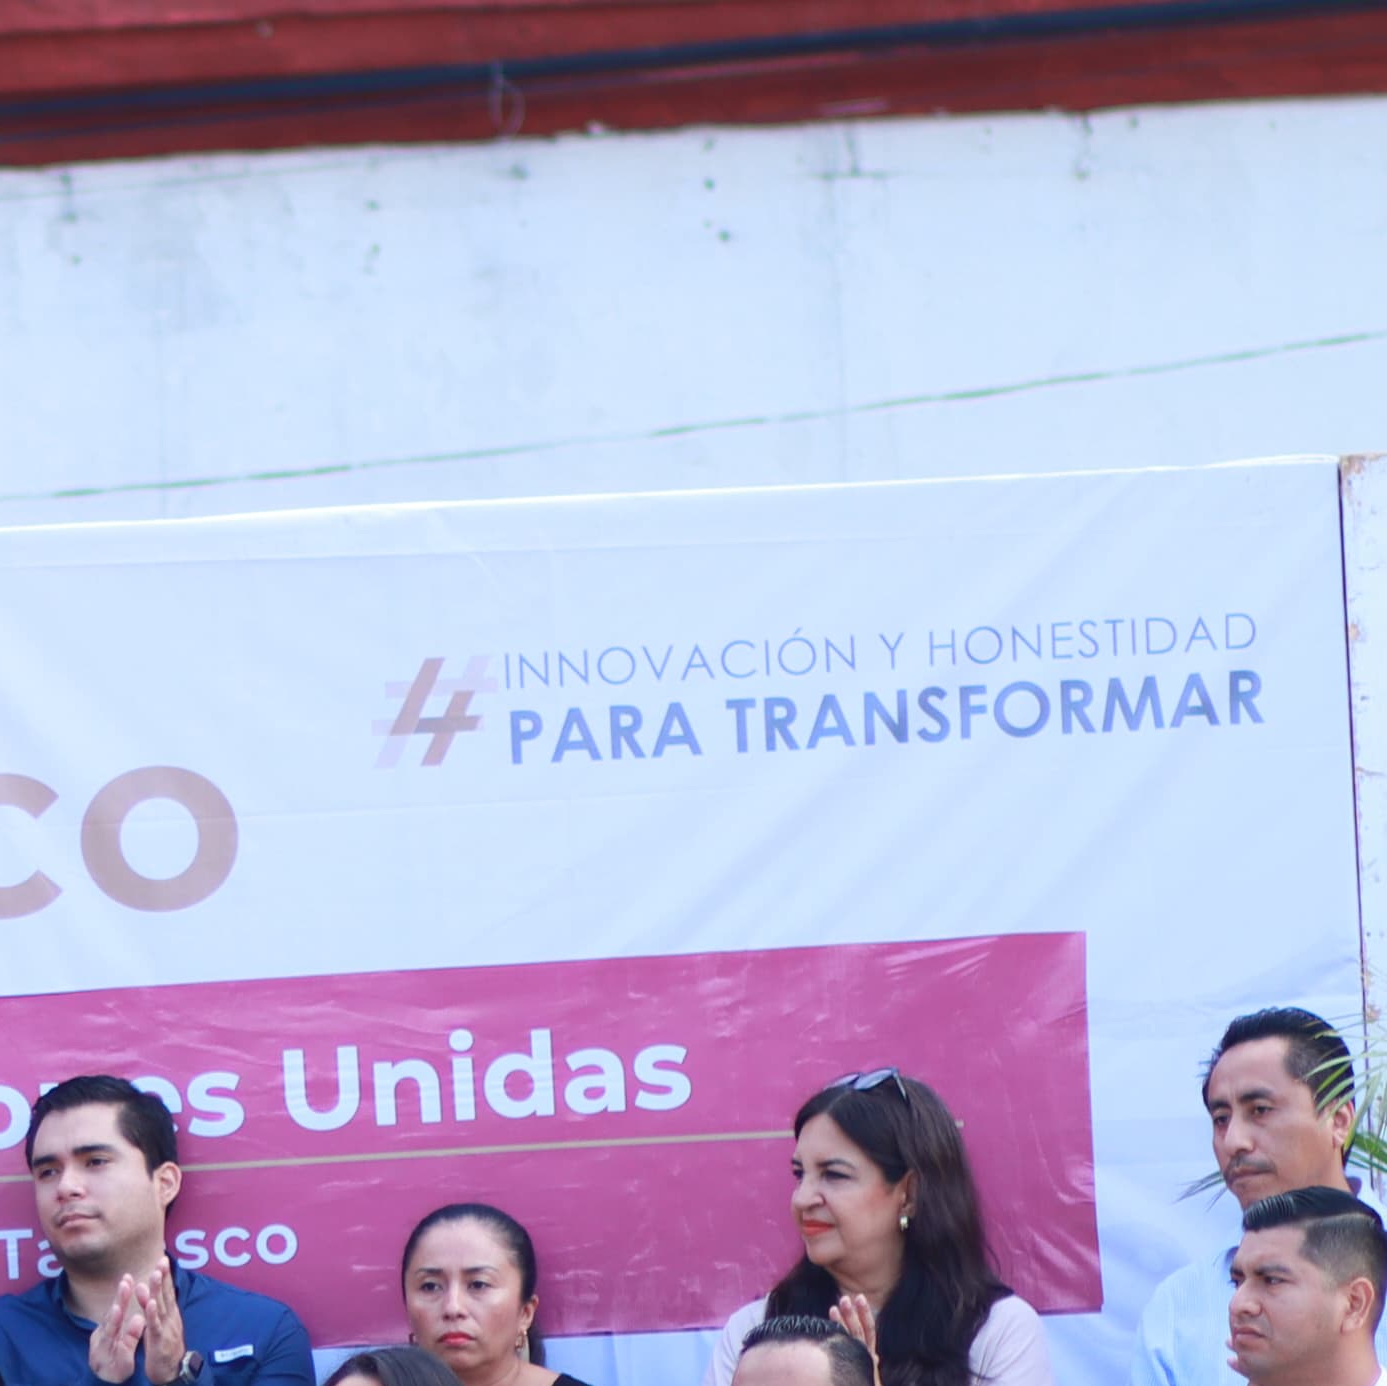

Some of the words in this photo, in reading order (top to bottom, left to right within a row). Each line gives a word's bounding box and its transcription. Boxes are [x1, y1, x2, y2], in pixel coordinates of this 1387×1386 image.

[504, 627, 857, 690] INNOVACIÓN
[879, 632, 905, 670] Y
[928, 613, 1257, 667] HONESTIDAD
[509, 701, 704, 765] PARA
[725, 670, 1266, 753] TRANSFORMAR
[281, 1027, 692, 1132] Unidas
